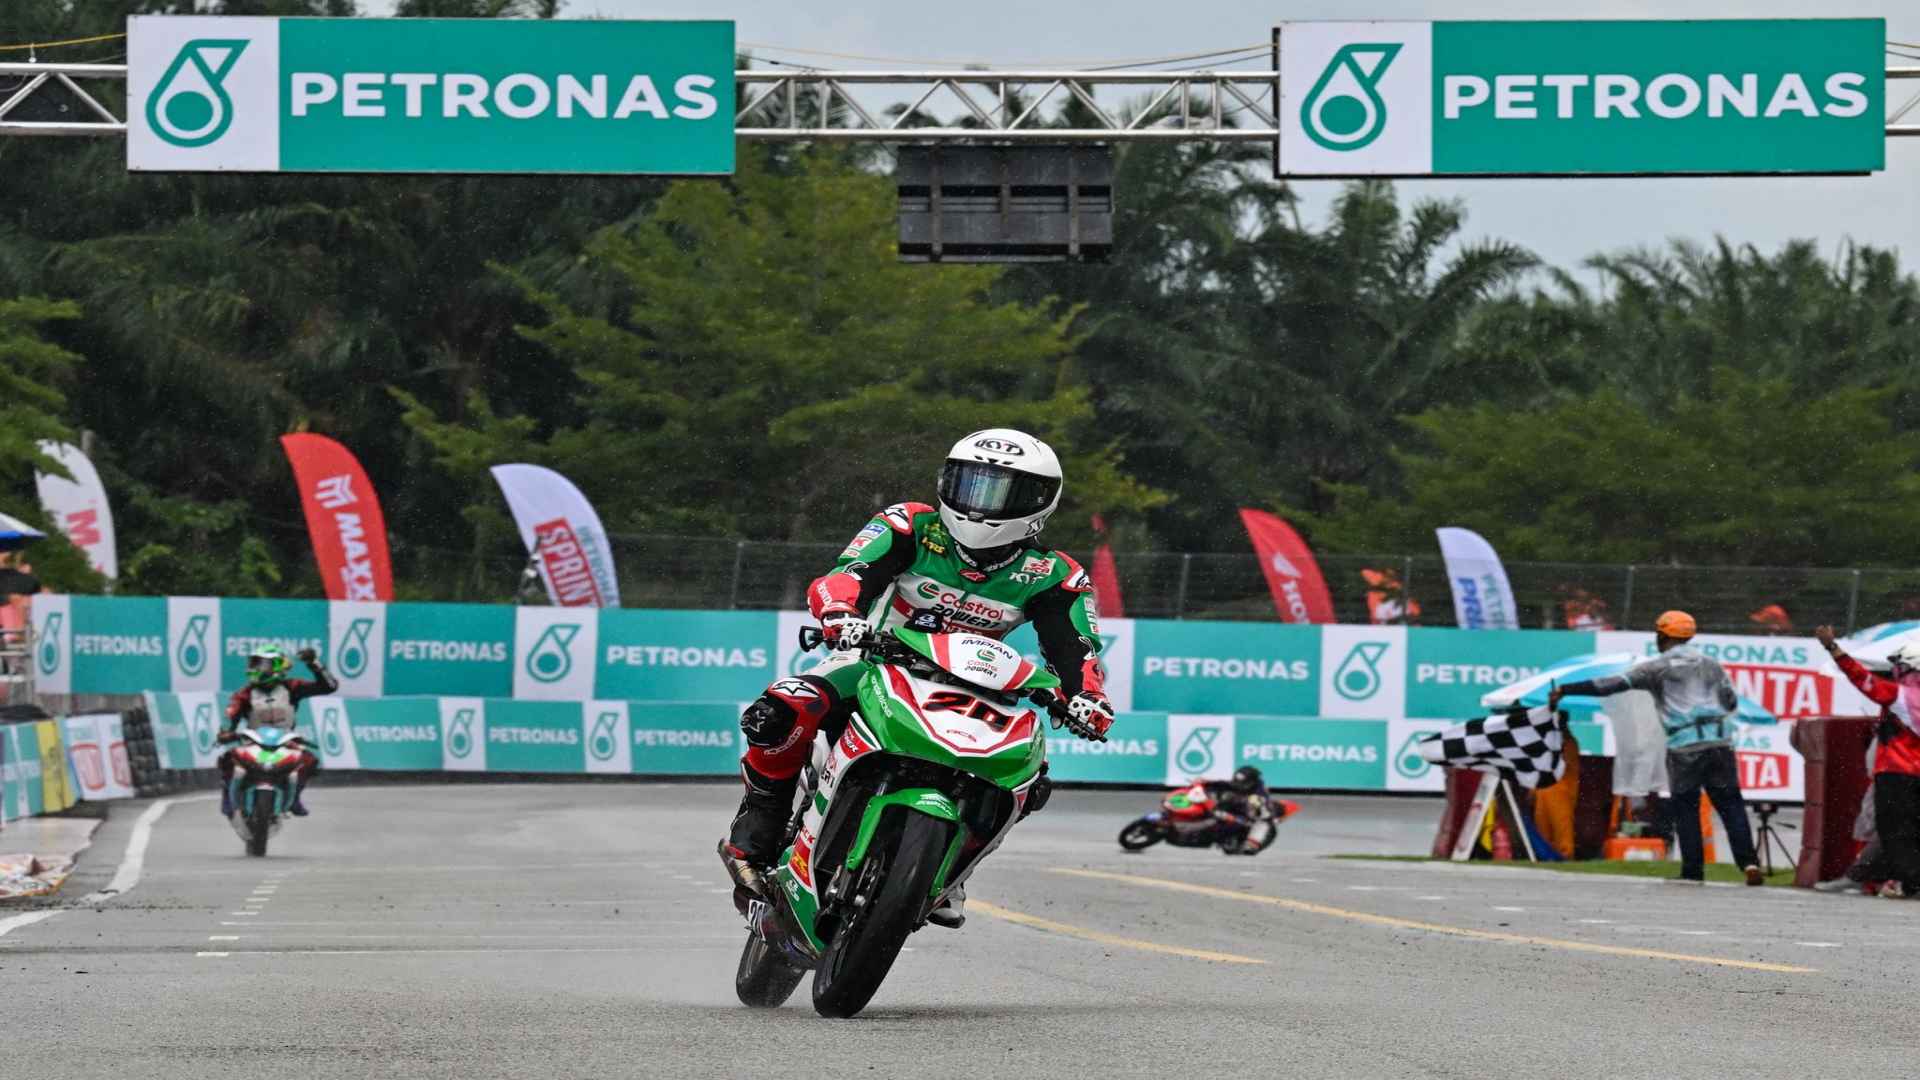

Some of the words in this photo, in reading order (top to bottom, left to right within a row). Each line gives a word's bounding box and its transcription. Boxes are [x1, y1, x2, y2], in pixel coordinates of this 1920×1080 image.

[290, 72, 718, 119] PETRONAS
[1443, 73, 1868, 119] PETRONAS
[335, 512, 377, 601] MAXX
[541, 526, 594, 602] SPRIN
[940, 592, 1004, 620] Castrol
[73, 635, 163, 656] PETRONAS
[389, 640, 507, 663] PETRONAS
[606, 645, 767, 668] PETRONAS
[961, 639, 1014, 660] IMPIAN
[1143, 656, 1309, 680] PETRONAS
[1416, 663, 1541, 685] PETRON
[353, 725, 438, 742] PETRONAS
[489, 727, 578, 744] PETRONAS
[634, 730, 733, 747] PETRONAS
[1045, 738, 1159, 756] ETRONAS
[1243, 744, 1377, 762] PETRONAS
